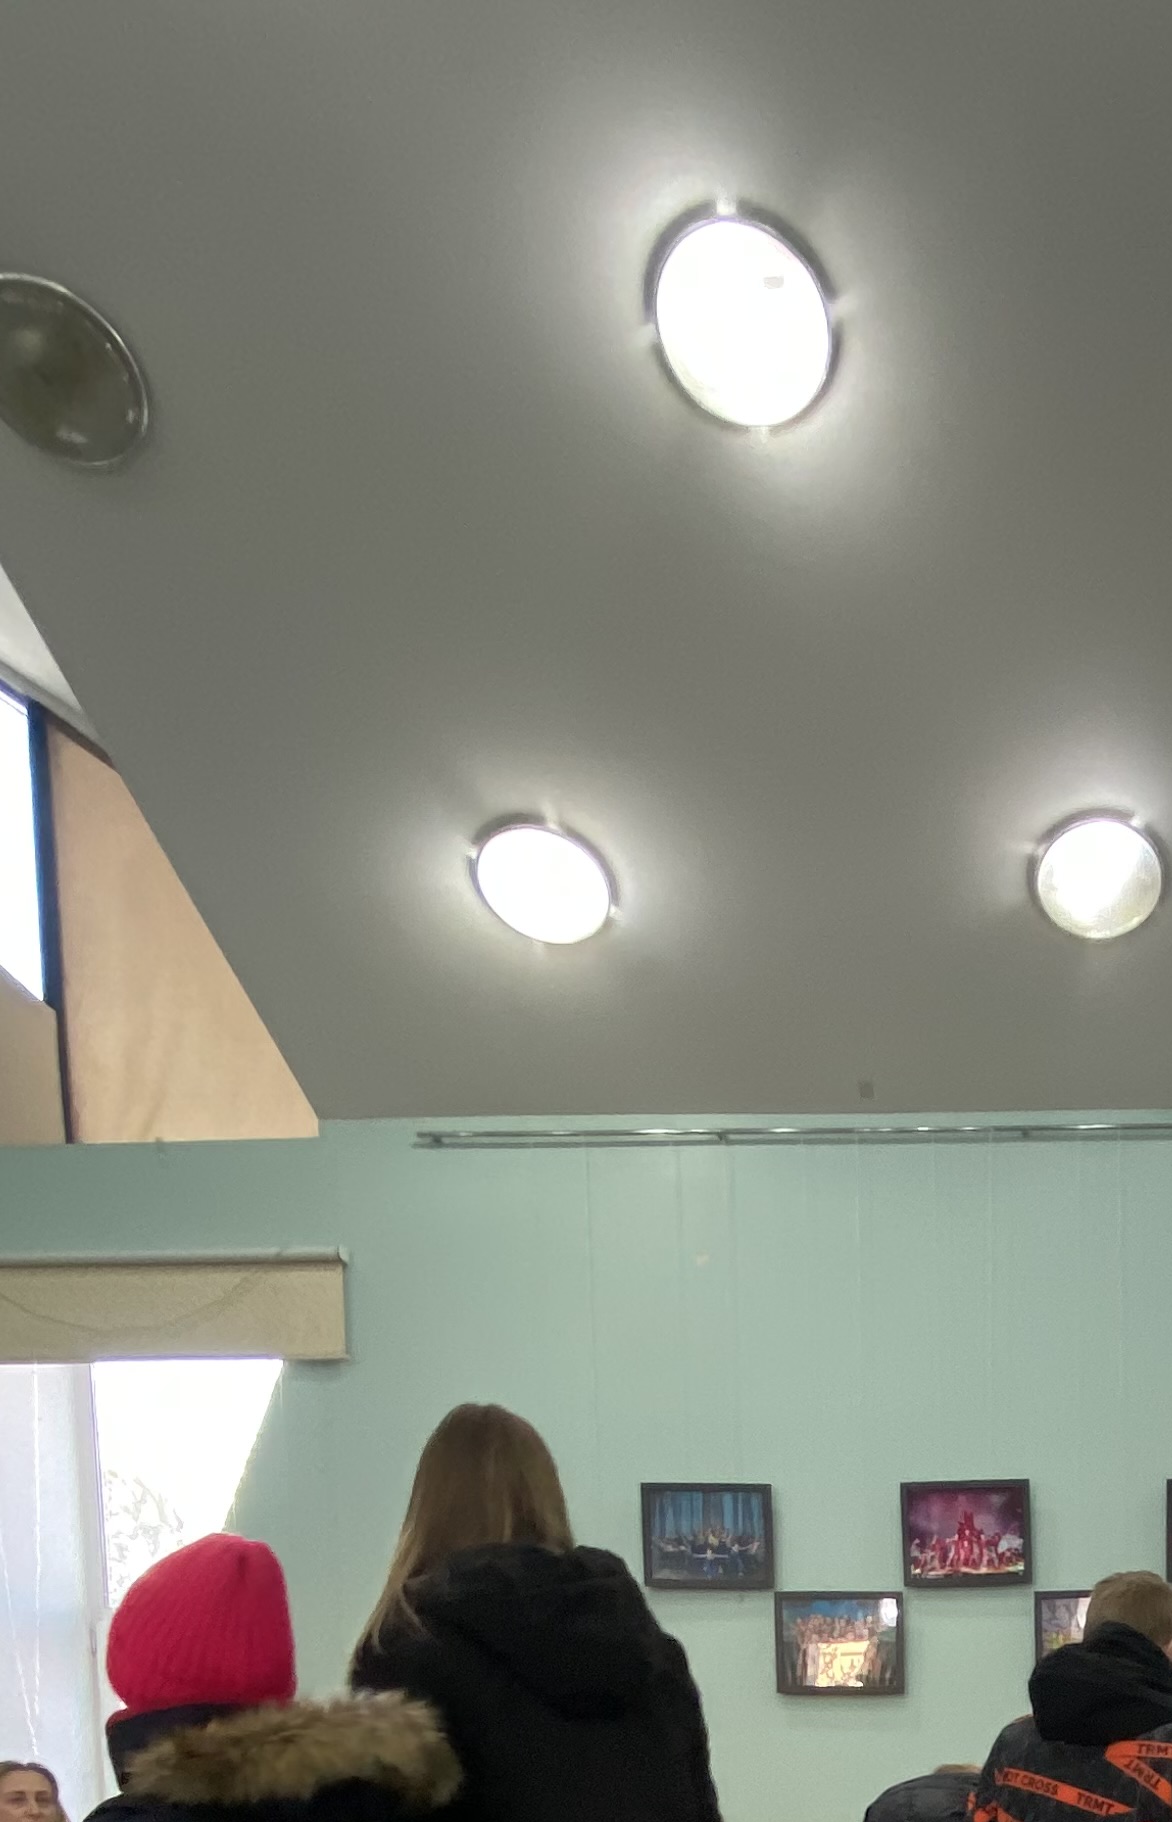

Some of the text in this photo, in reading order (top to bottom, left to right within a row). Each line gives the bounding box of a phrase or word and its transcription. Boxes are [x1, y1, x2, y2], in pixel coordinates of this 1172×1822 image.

[1123, 1758, 1162, 1791] TRMT
[1021, 1774, 1059, 1796] CROSS
[1077, 1792, 1115, 1814] TRMT
